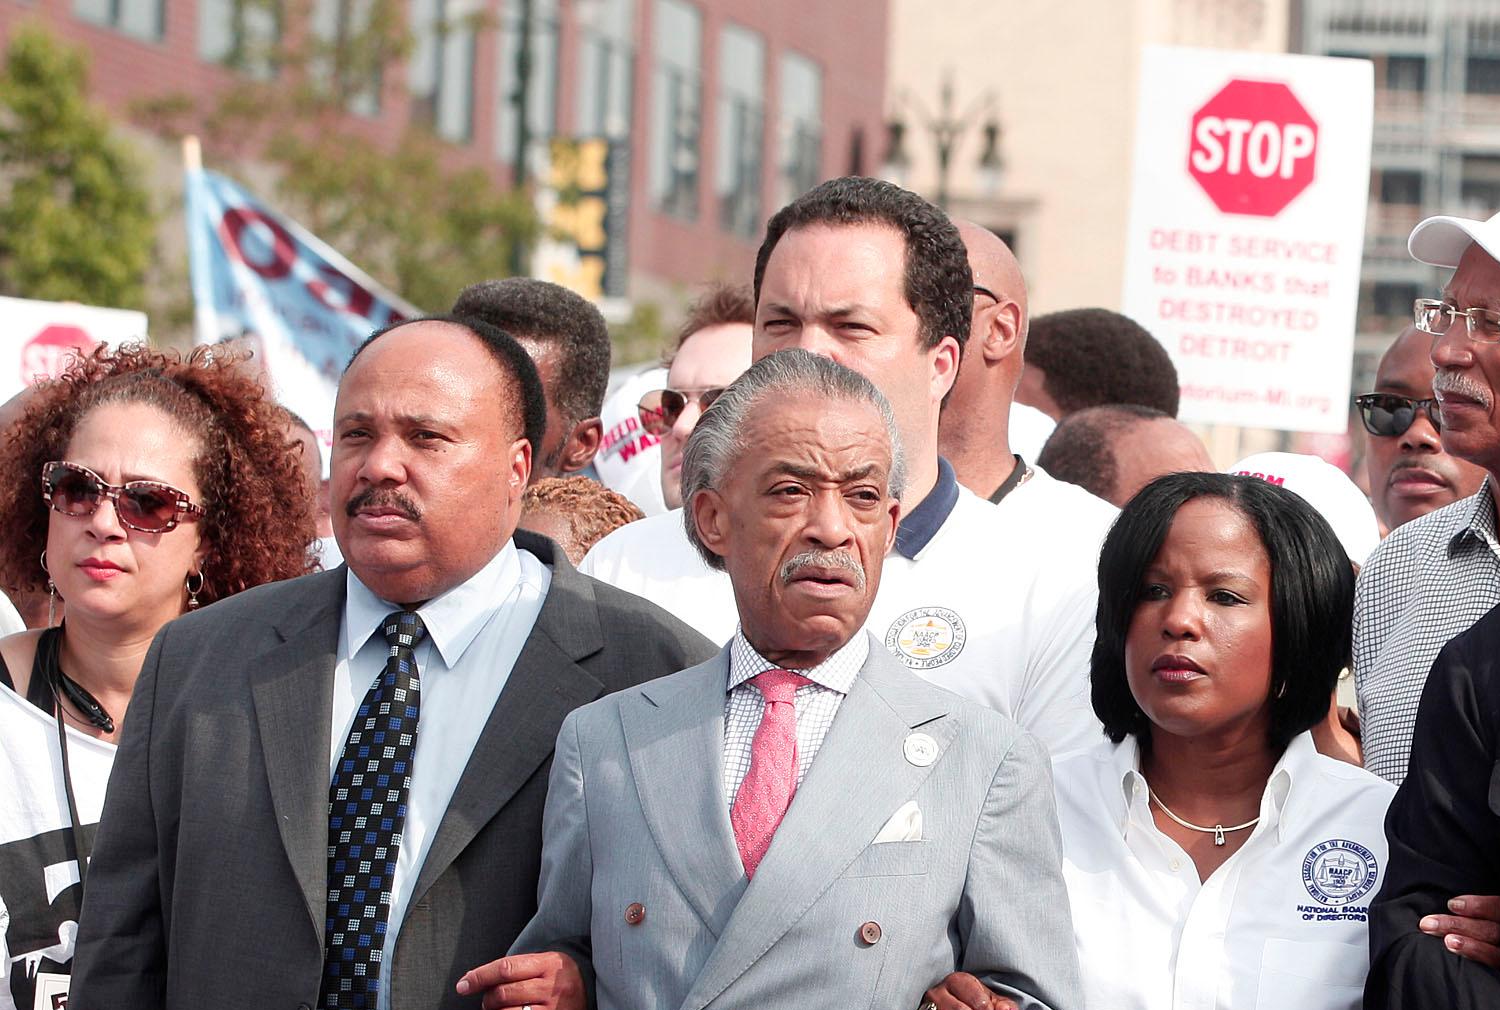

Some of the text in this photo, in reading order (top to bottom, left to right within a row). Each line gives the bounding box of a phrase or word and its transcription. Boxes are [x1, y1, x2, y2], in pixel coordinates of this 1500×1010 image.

[1192, 116, 1315, 180] STOP
[1149, 229, 1337, 264] DEBT SERVICE
[1153, 267, 1176, 284] to
[1186, 267, 1275, 293] BANKS
[1159, 298, 1318, 331] DESTROYED
[1179, 334, 1291, 362] DETROIT
[1297, 905, 1368, 914] NATIONAL BOAR
[1317, 914, 1366, 922] DIRECTORS
